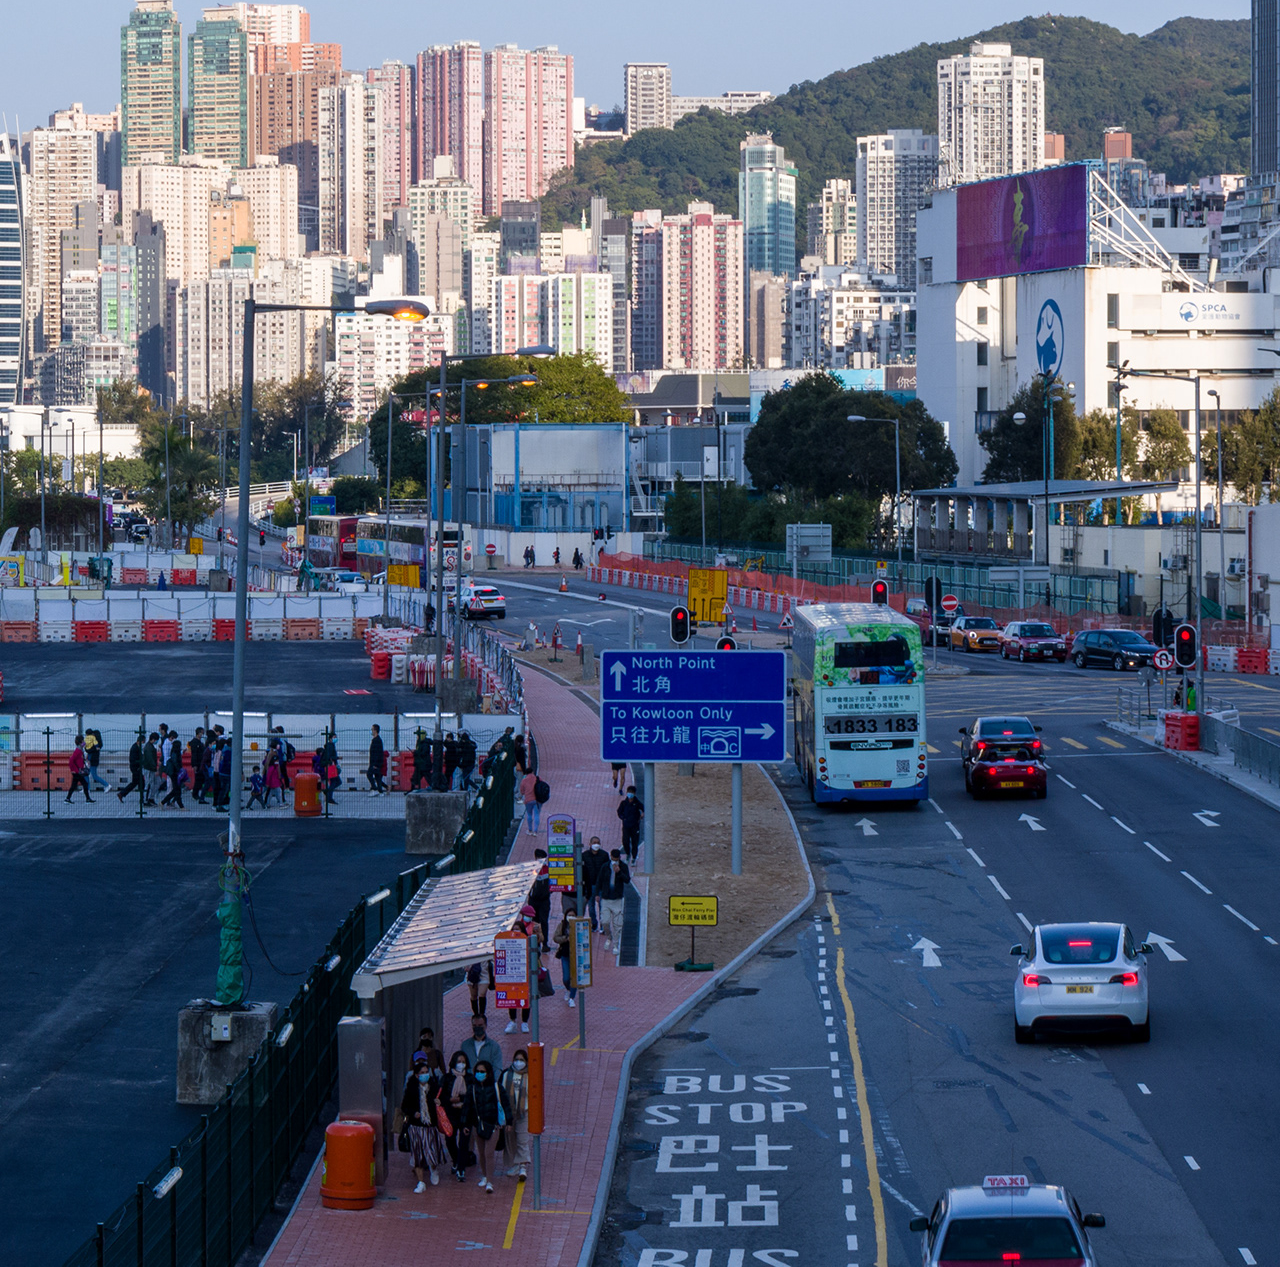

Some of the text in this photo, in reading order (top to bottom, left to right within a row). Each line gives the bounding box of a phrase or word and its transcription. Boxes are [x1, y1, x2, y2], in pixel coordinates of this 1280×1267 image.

[1201, 304, 1227, 312] SPCA
[631, 657, 716, 669] North Point
[632, 675, 671, 694] 北角
[609, 707, 732, 721] To Kowloon Only
[610, 725, 691, 744] 只往九龍
[834, 718, 917, 733] 1833 183
[496, 950, 505, 958] 641
[663, 1074, 791, 1094] BUS
[644, 1102, 808, 1125] STOP
[655, 1134, 793, 1172] 巴士
[988, 1177, 1025, 1186] TAXI
[669, 1184, 779, 1227] 站
[637, 1248, 800, 1267] BUS
